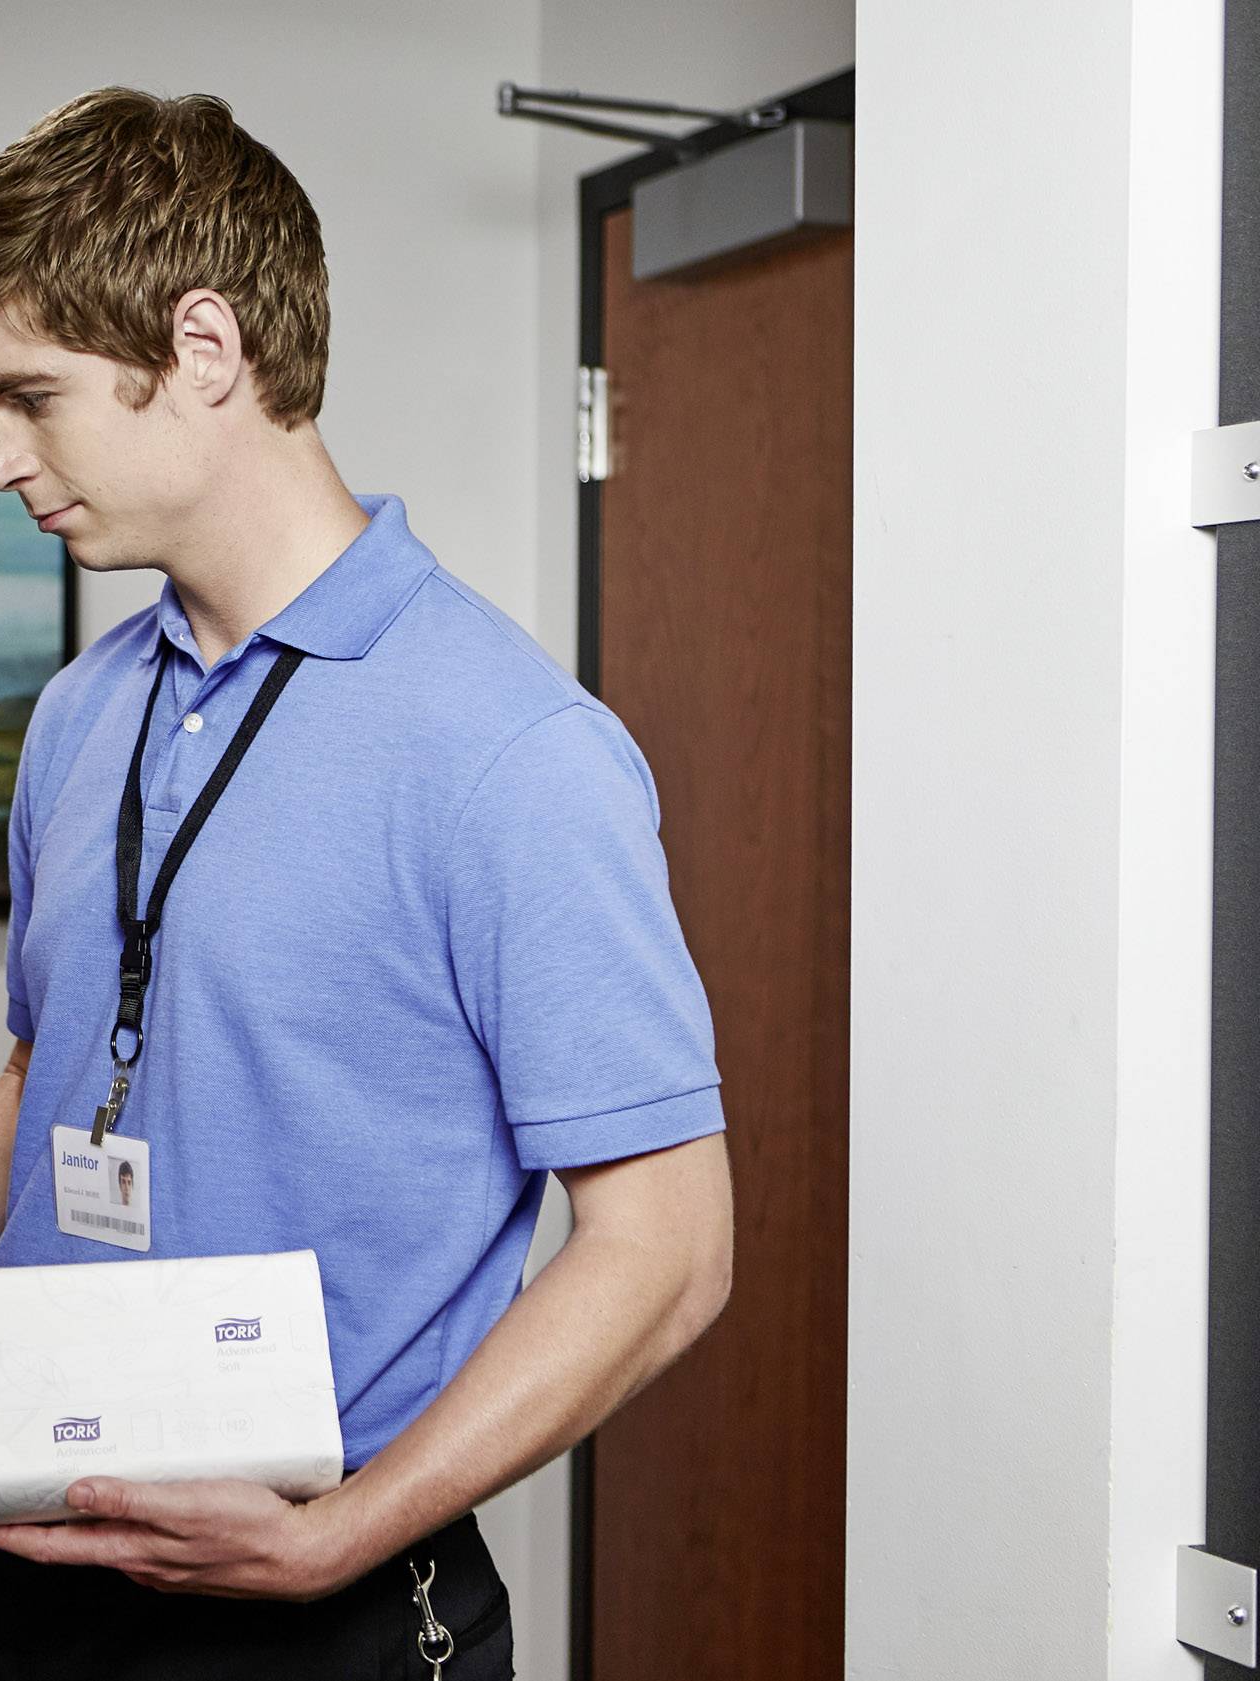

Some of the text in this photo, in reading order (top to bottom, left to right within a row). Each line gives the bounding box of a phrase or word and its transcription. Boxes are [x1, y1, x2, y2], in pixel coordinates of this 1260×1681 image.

[61, 1151, 99, 1171] Janitor
[216, 1325, 259, 1340] TORK
[55, 1424, 98, 1440] TORK
